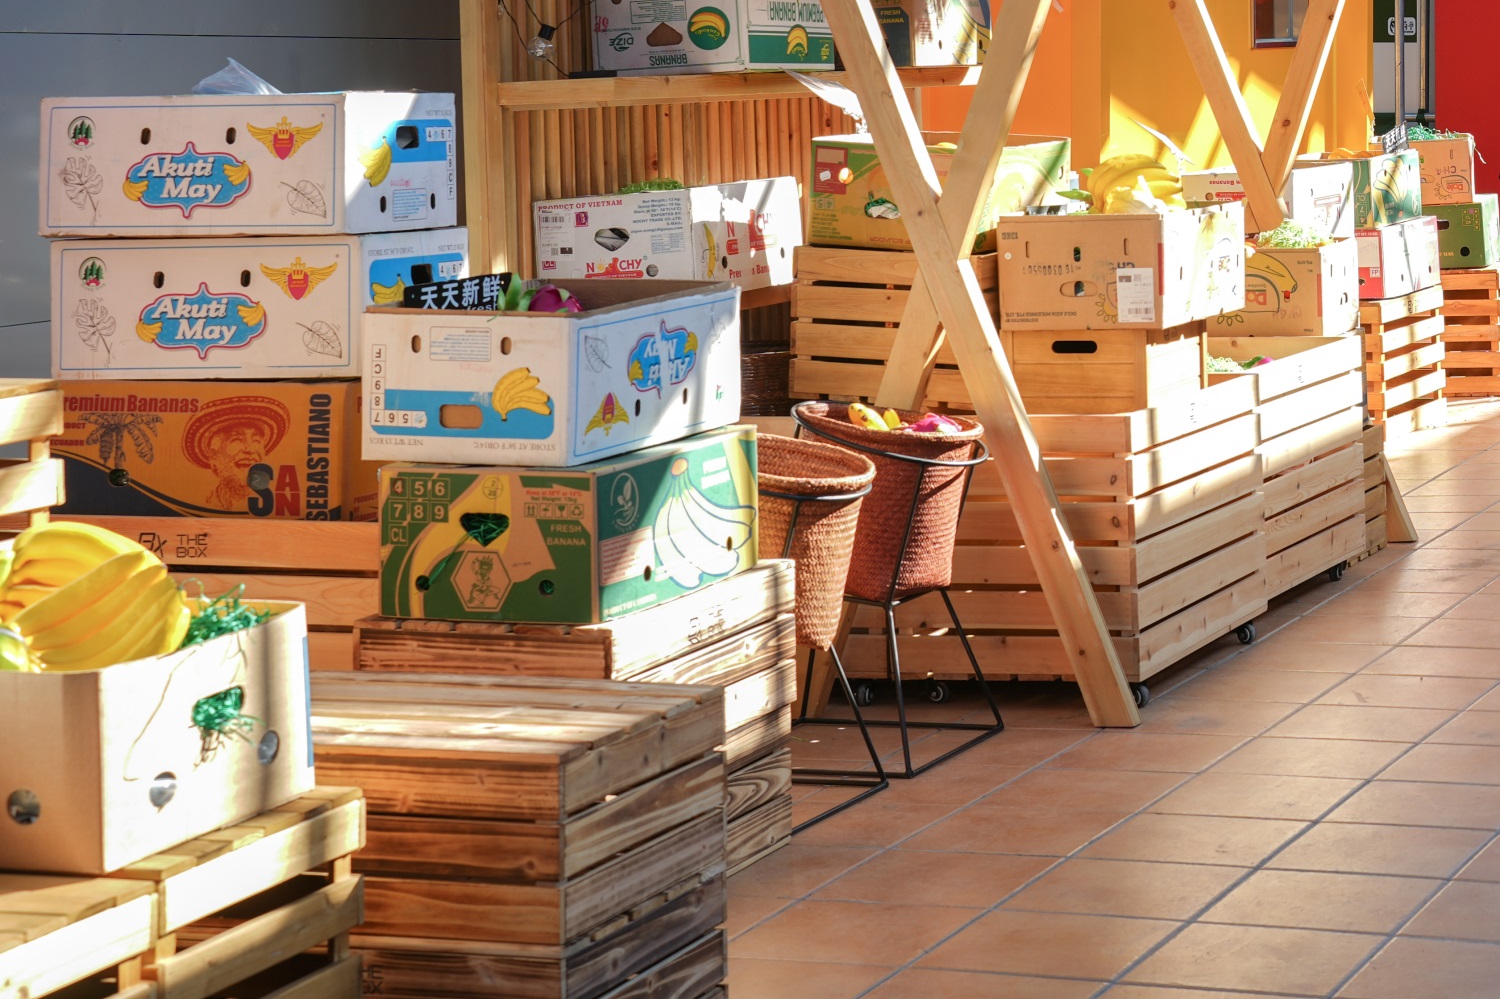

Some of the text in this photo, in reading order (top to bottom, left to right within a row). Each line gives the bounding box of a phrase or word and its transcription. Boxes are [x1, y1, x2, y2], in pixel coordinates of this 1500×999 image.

[769, 1, 824, 23] PREMIUM BANANA
[609, 37, 634, 47] DIZE
[650, 54, 688, 66] BANANAS
[138, 156, 215, 178] Akuti
[160, 177, 222, 203] May
[1446, 183, 1464, 191] Dole
[587, 199, 623, 208] VIETNAM
[151, 297, 228, 319] Akuti
[176, 321, 237, 346] May
[62, 394, 200, 413] remium Bananas
[369, 437, 384, 445] KGS
[408, 438, 423, 446] NET
[529, 443, 556, 451] STORE
[306, 394, 332, 521] SEBASTIANO
[550, 524, 582, 533] FRESH
[176, 534, 208, 545] THE
[391, 528, 406, 543] CL
[546, 537, 587, 546] BANANA
[176, 546, 208, 558] BOX
